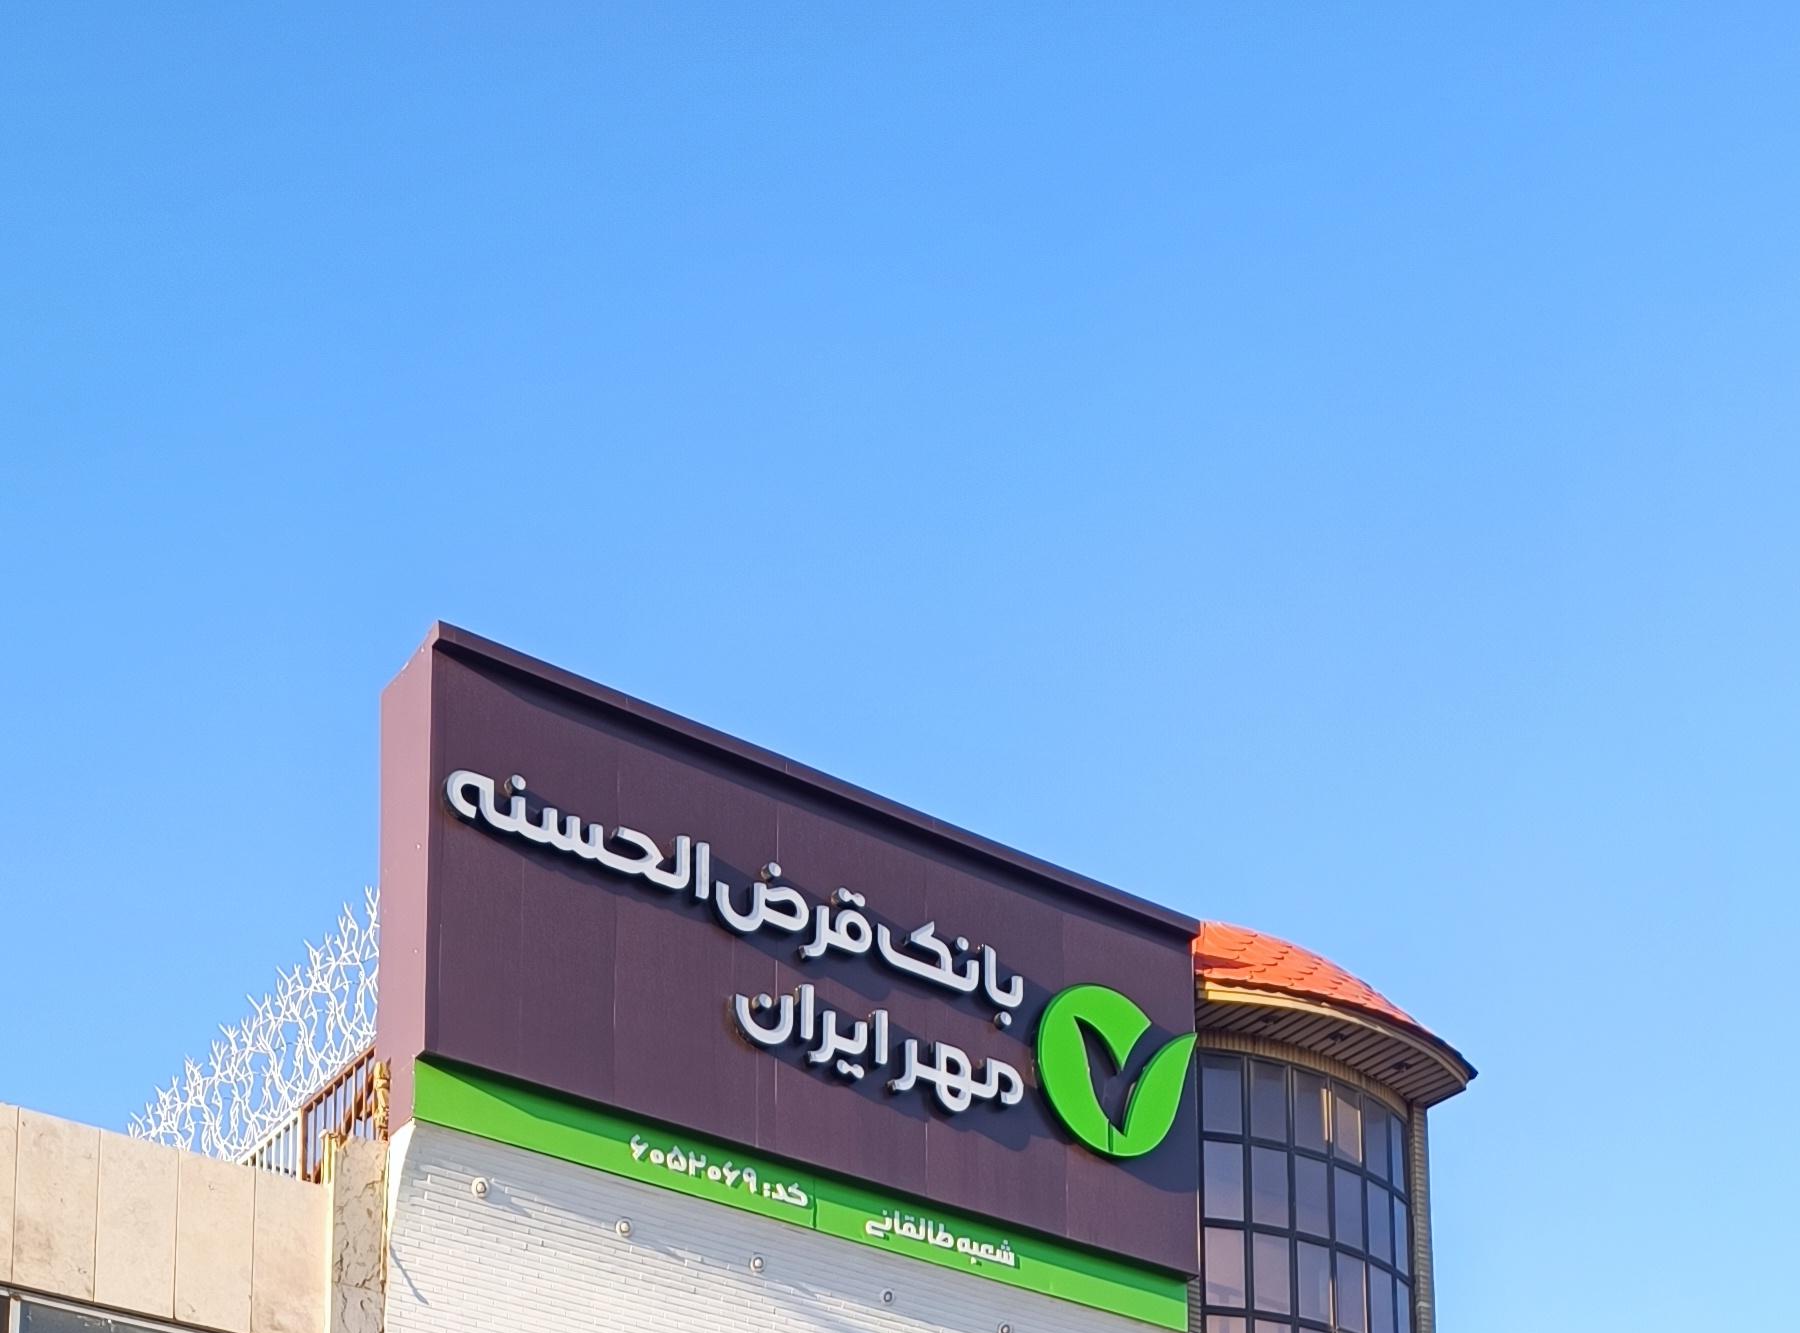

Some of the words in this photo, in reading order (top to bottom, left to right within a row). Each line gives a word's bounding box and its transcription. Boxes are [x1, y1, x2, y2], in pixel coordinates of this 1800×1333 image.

[444, 768, 712, 899] الحسنه
[714, 861, 873, 957] قرض
[878, 920, 1026, 1026] بانک
[731, 984, 890, 1079] ایران
[889, 1038, 1026, 1113] مهر
[629, 1133, 758, 1194] ۶۰۵۲۰۶۹
[762, 1182, 809, 1207] کد:
[864, 1209, 955, 1249] طالقانی
[956, 1239, 1016, 1267] شعبه
